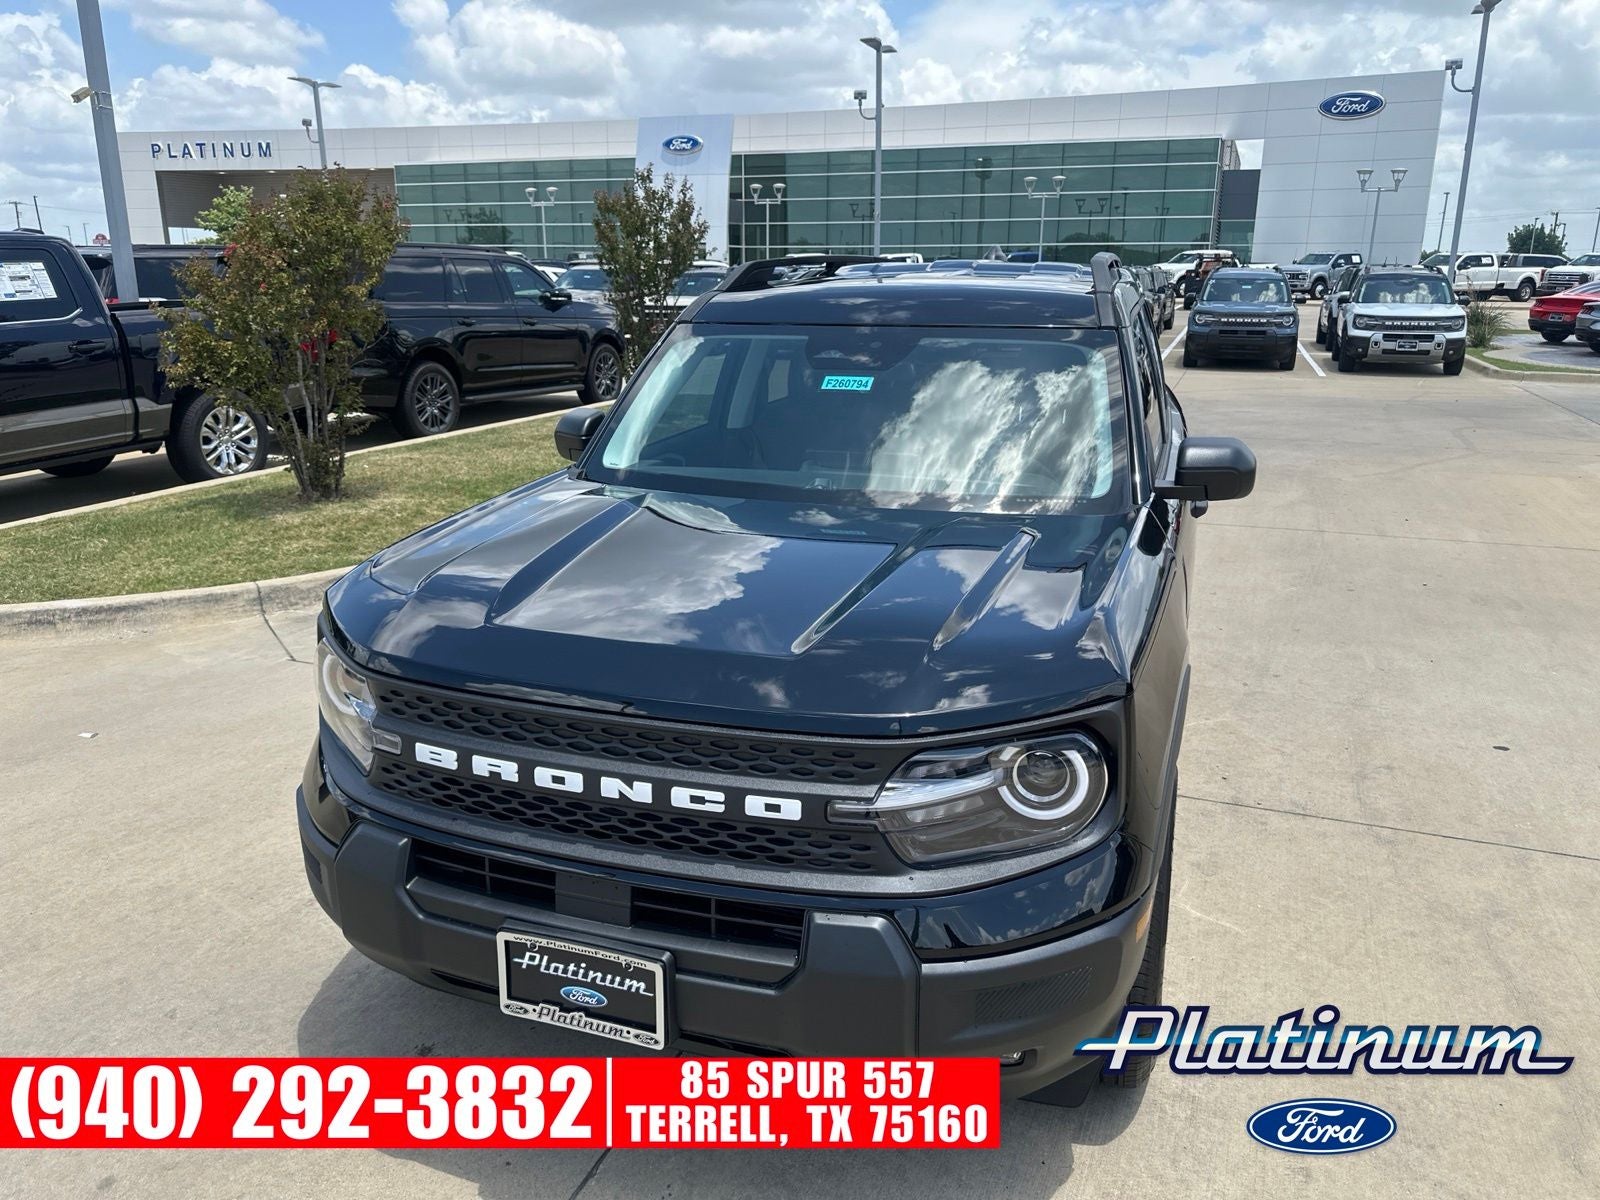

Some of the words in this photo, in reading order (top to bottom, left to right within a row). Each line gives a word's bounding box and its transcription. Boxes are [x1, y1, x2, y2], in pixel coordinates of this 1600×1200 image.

[1331, 96, 1371, 114] Ford
[150, 140, 273, 160] PLATINUM
[669, 138, 694, 151] Ford
[825, 378, 870, 389] F260794
[415, 742, 803, 822] BRONCO
[513, 935, 648, 969] www.PlatinumFord.com
[512, 951, 655, 997] Platinum
[569, 988, 599, 1006] Ford
[537, 1004, 631, 1041] Platinum
